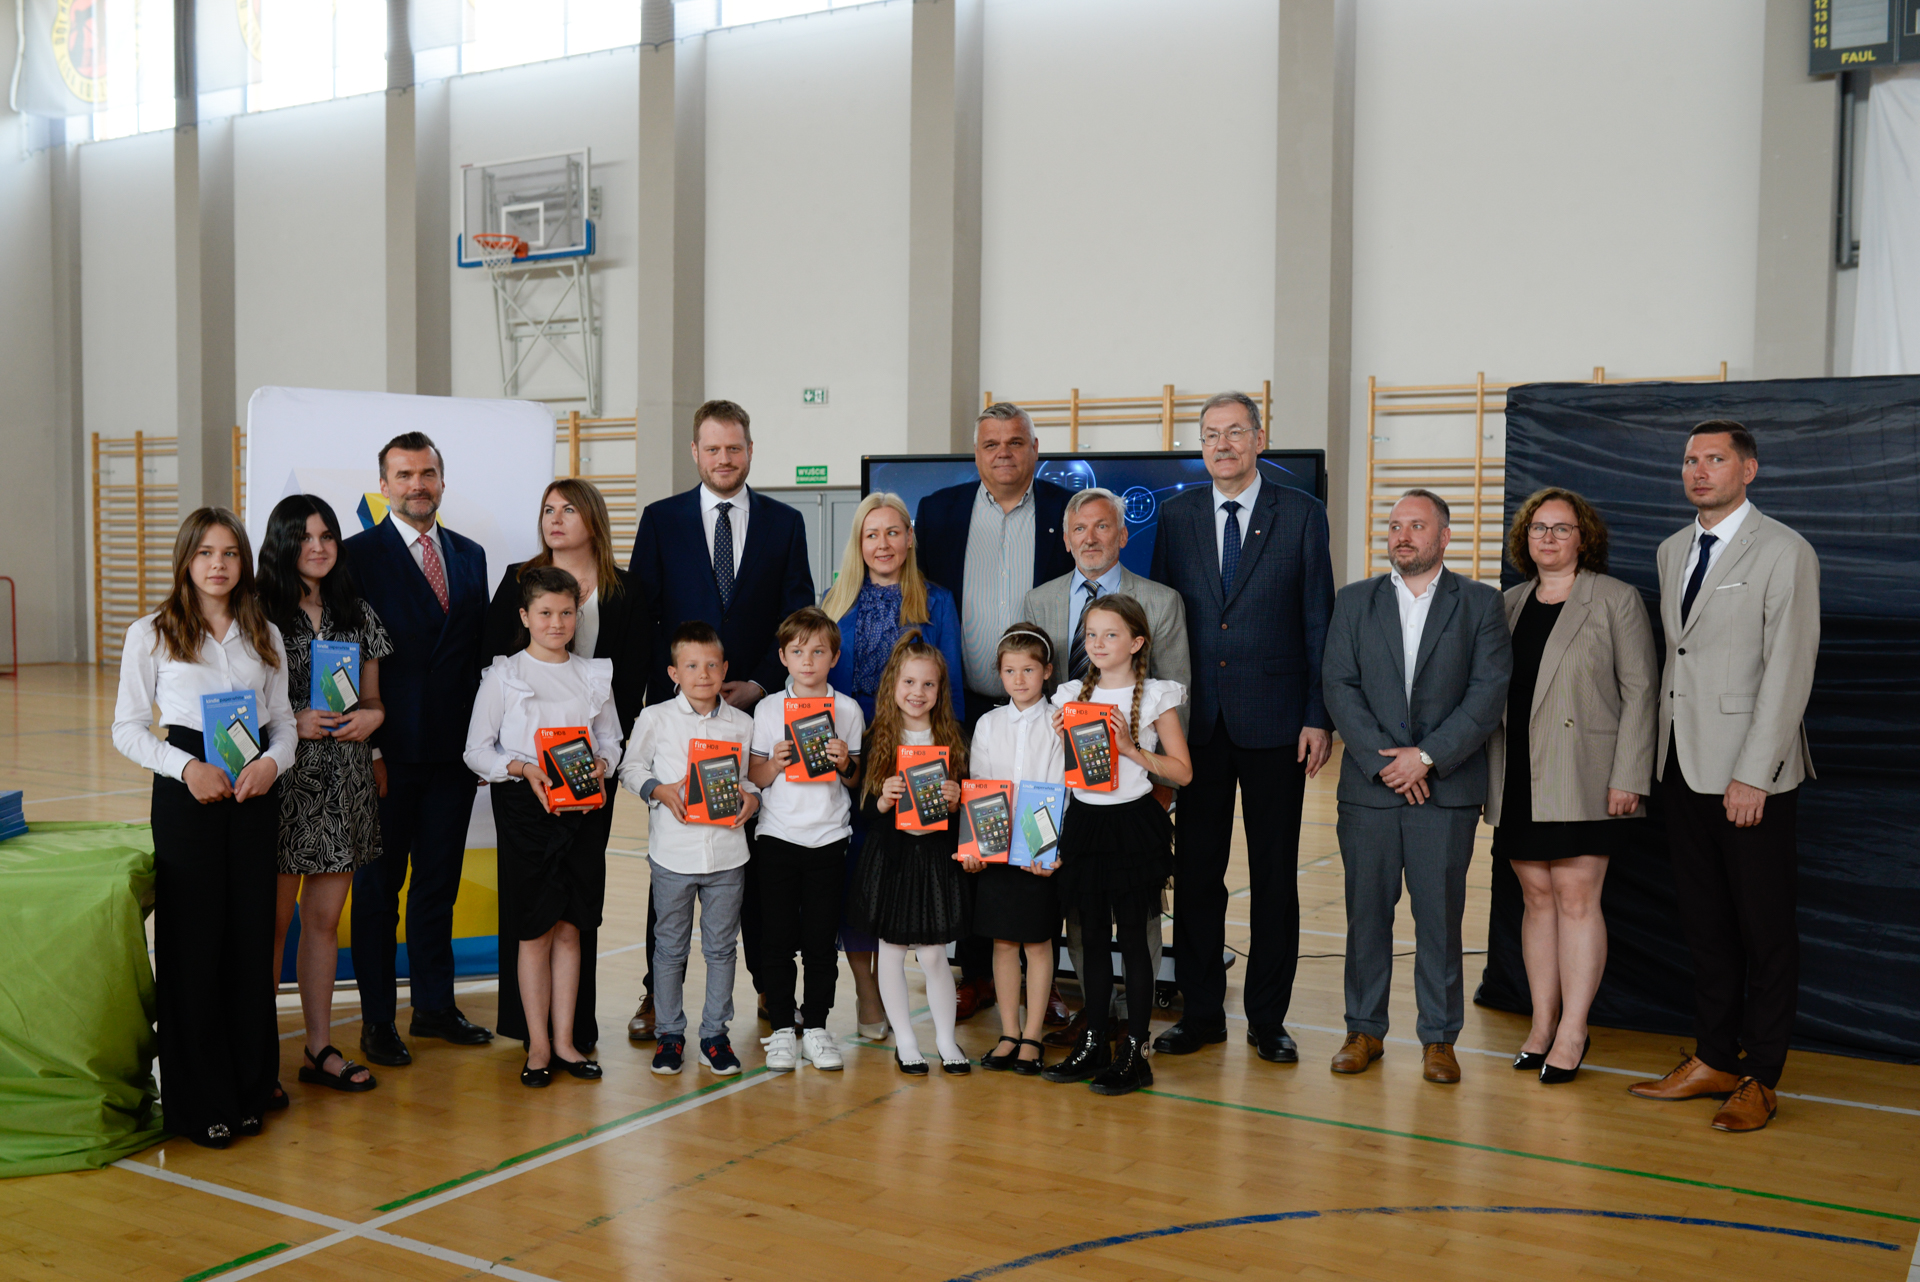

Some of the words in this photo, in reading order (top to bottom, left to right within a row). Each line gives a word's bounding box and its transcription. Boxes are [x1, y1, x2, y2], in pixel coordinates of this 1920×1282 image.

[1814, 0, 1828, 9] 12
[1814, 10, 1828, 23] 13
[1813, 23, 1828, 36] 14
[1813, 36, 1828, 49] 15
[1841, 50, 1877, 64] FAUL
[797, 467, 826, 476] WYJŚCIE
[786, 701, 798, 709] fire
[1065, 706, 1076, 714] fire
[694, 741, 706, 749] fire
